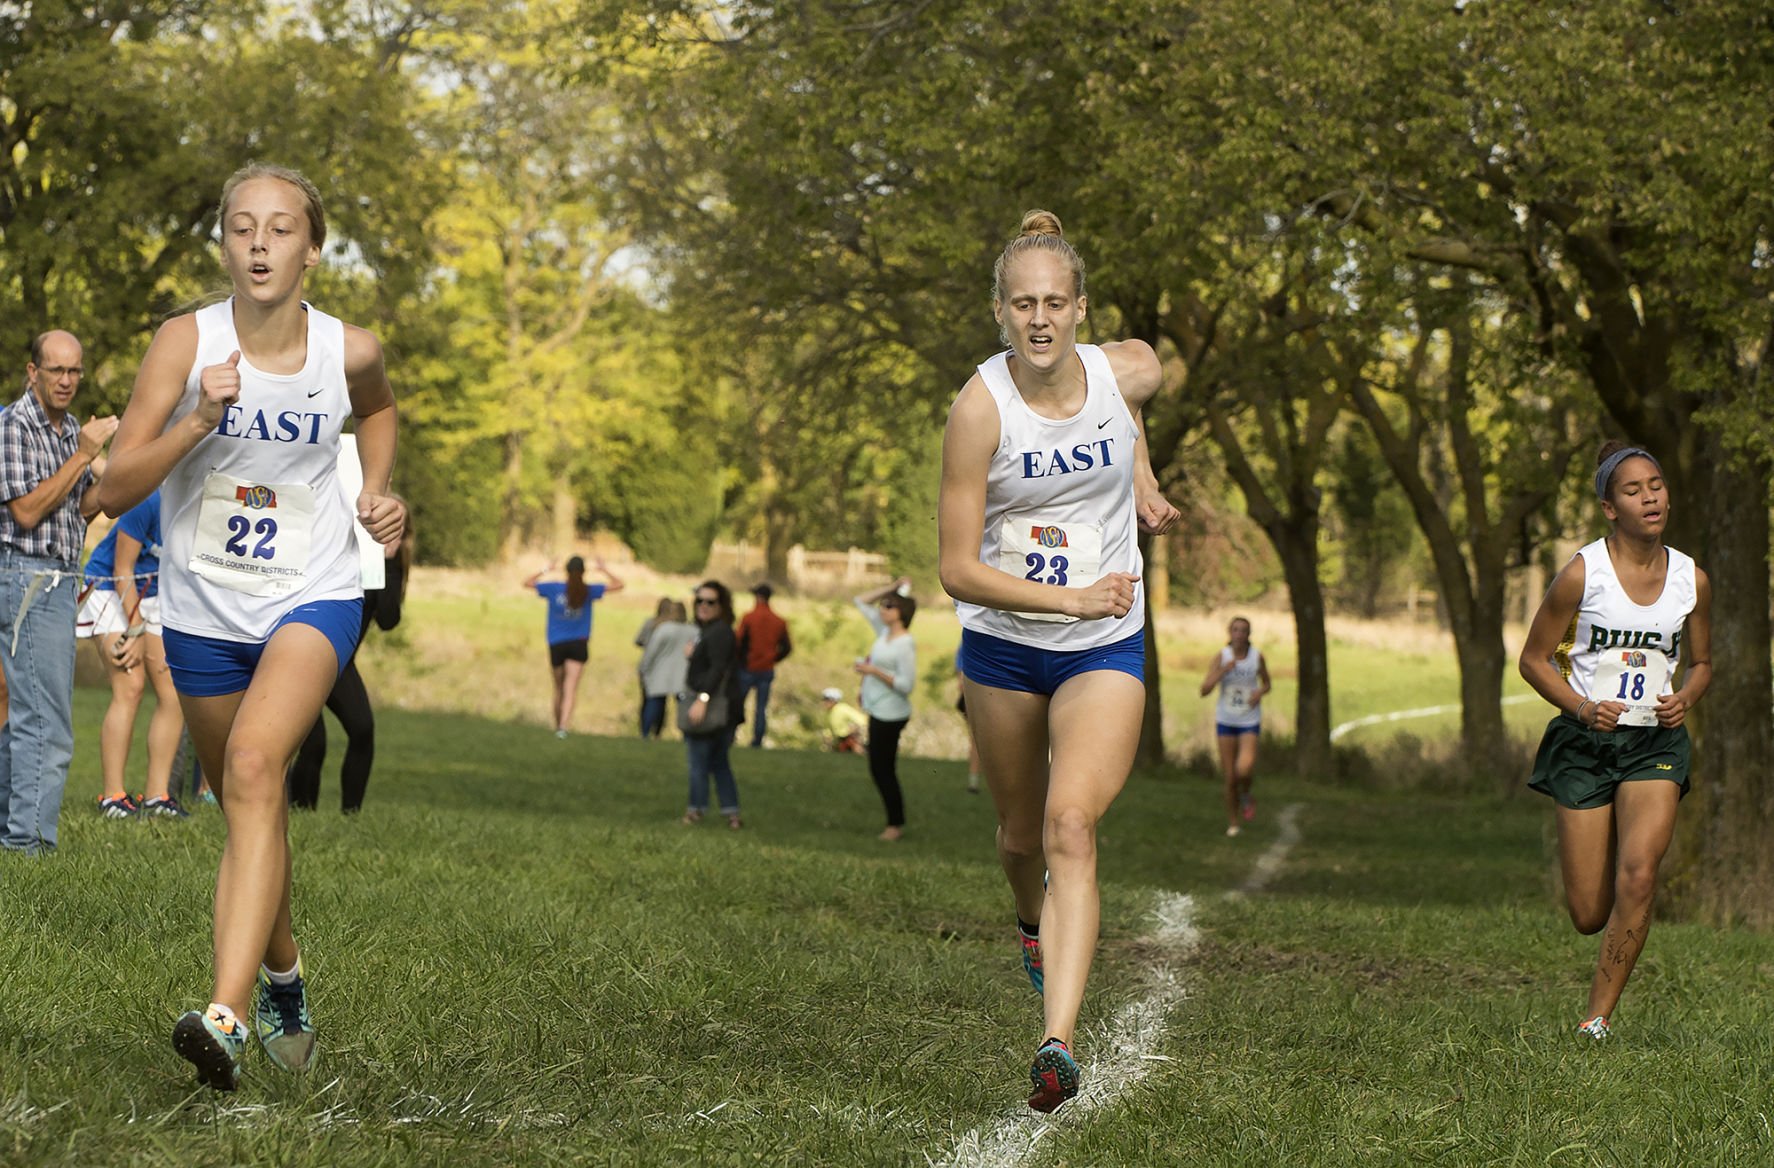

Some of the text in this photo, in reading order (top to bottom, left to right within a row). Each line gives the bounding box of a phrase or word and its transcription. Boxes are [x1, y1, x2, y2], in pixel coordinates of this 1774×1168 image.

[214, 405, 328, 444] EAST
[1021, 438, 1114, 479] EAST
[225, 515, 278, 560] 22
[200, 553, 299, 577] CROSS COUNTRY DISTRICTS
[1025, 552, 1069, 587] 23
[1616, 672, 1645, 700] 18
